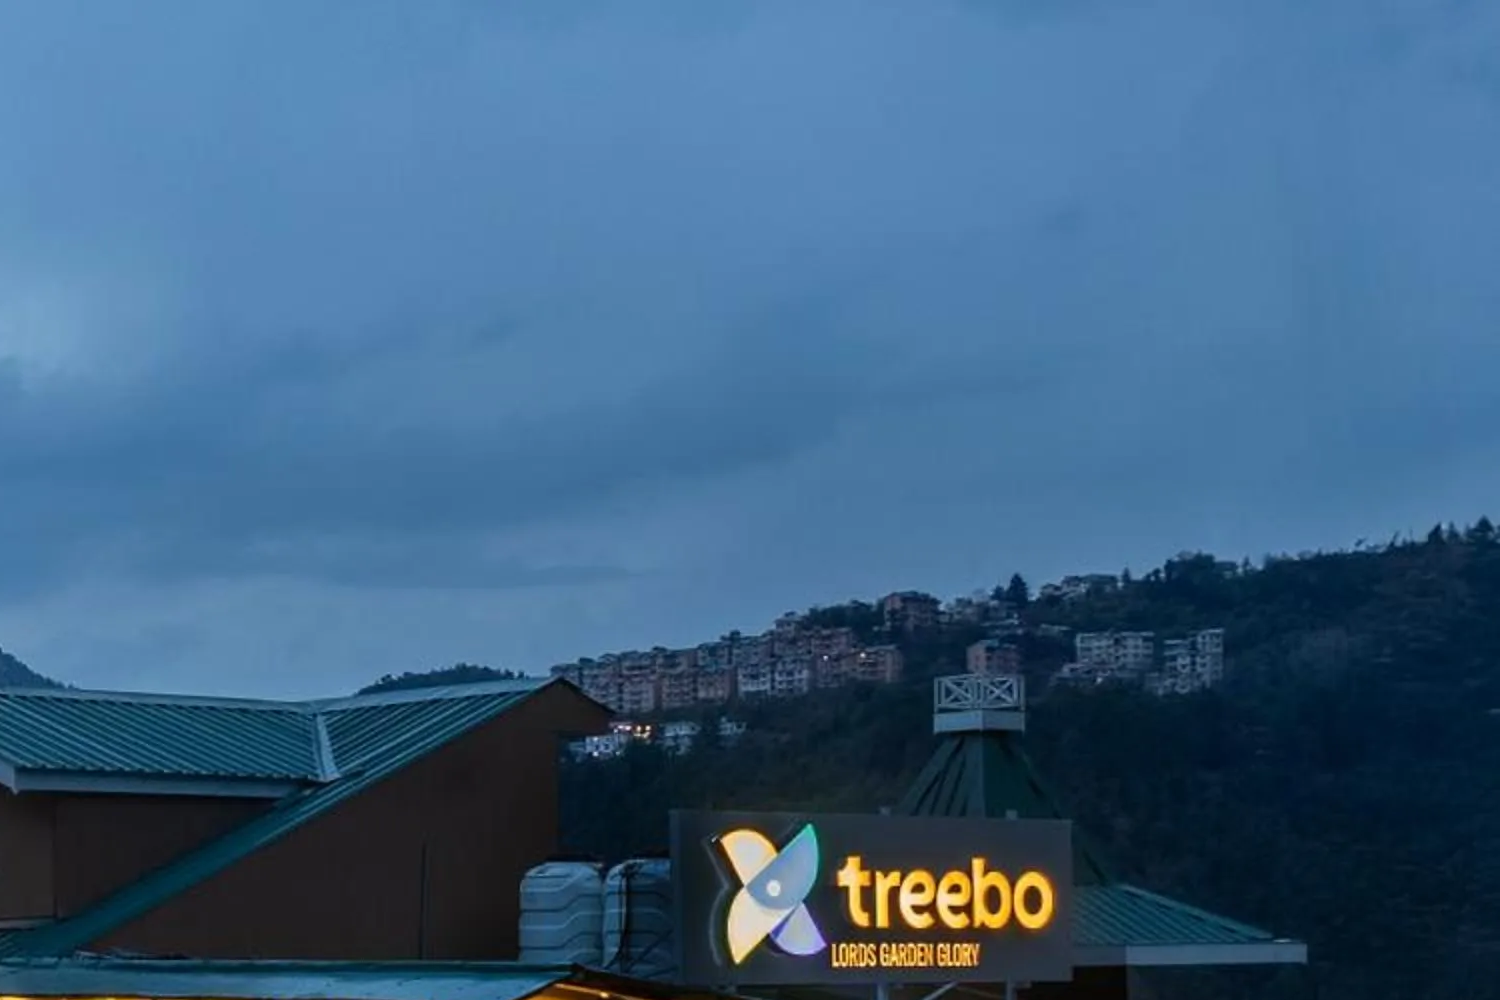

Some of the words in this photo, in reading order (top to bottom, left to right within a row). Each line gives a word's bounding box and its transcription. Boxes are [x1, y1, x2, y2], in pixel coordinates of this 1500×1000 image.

[837, 855, 1054, 929] treebo
[831, 943, 877, 967] LORDS
[879, 943, 934, 967] GARDEN
[936, 943, 980, 967] GLORY
